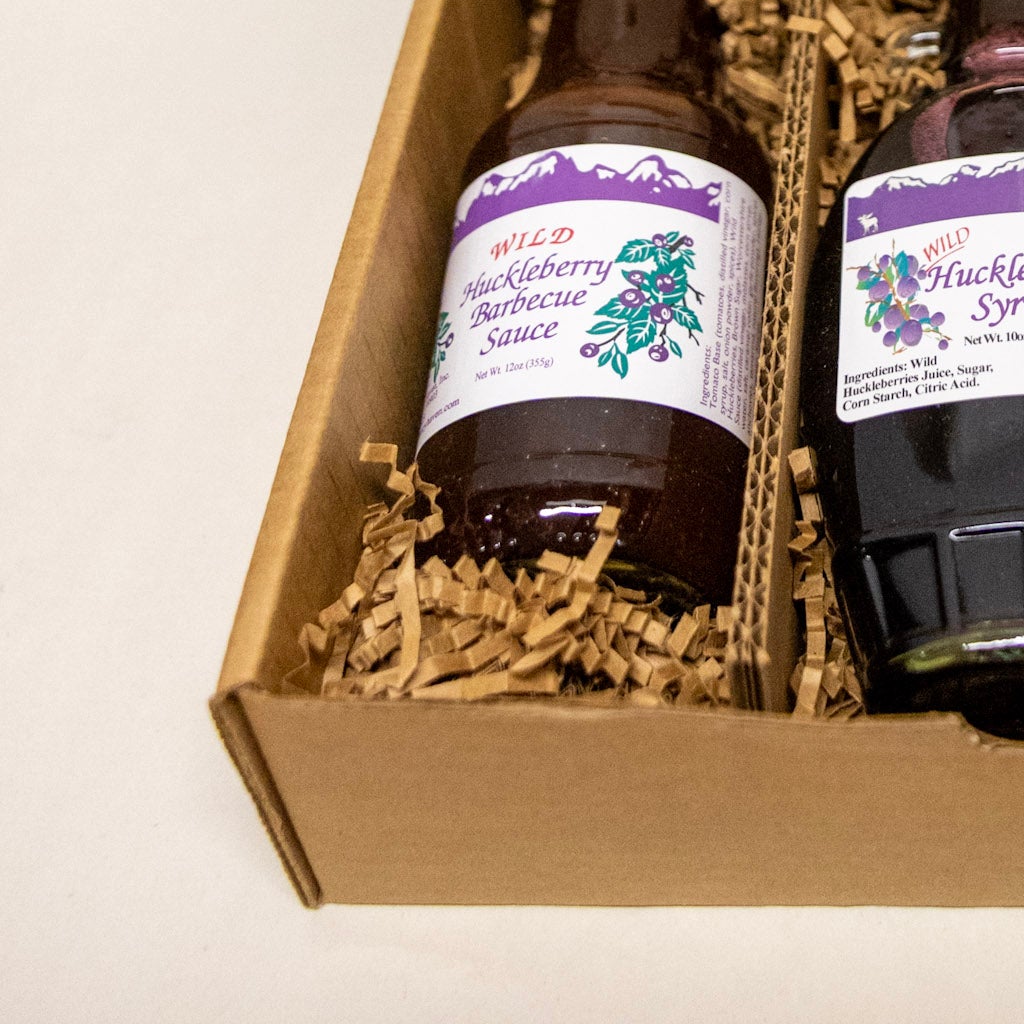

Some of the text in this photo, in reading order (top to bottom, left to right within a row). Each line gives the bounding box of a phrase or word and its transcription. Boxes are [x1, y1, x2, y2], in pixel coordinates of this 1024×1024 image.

[490, 227, 575, 262] WILD
[719, 244, 728, 281] distilled
[923, 226, 970, 262] WILD
[459, 253, 616, 308] Huckleberry
[723, 327, 731, 357] onion
[730, 217, 738, 241] Wild
[469, 286, 588, 329] Barbecue
[732, 307, 740, 341] Brown
[479, 319, 559, 356] Sauce
[713, 341, 722, 365] Base
[964, 334, 982, 346] Net
[984, 333, 1003, 344] Wt.
[474, 371, 488, 382] Net
[505, 362, 524, 373] 12oz
[525, 357, 554, 370] (355g)
[700, 345, 712, 406] Ingredients:
[843, 355, 938, 386] Ingredients: Wild
[843, 362, 994, 399] Huckleberries Juice, Sugar,
[710, 368, 720, 409] Tomato
[842, 375, 980, 412] Corn Starch, Citric Acid.
